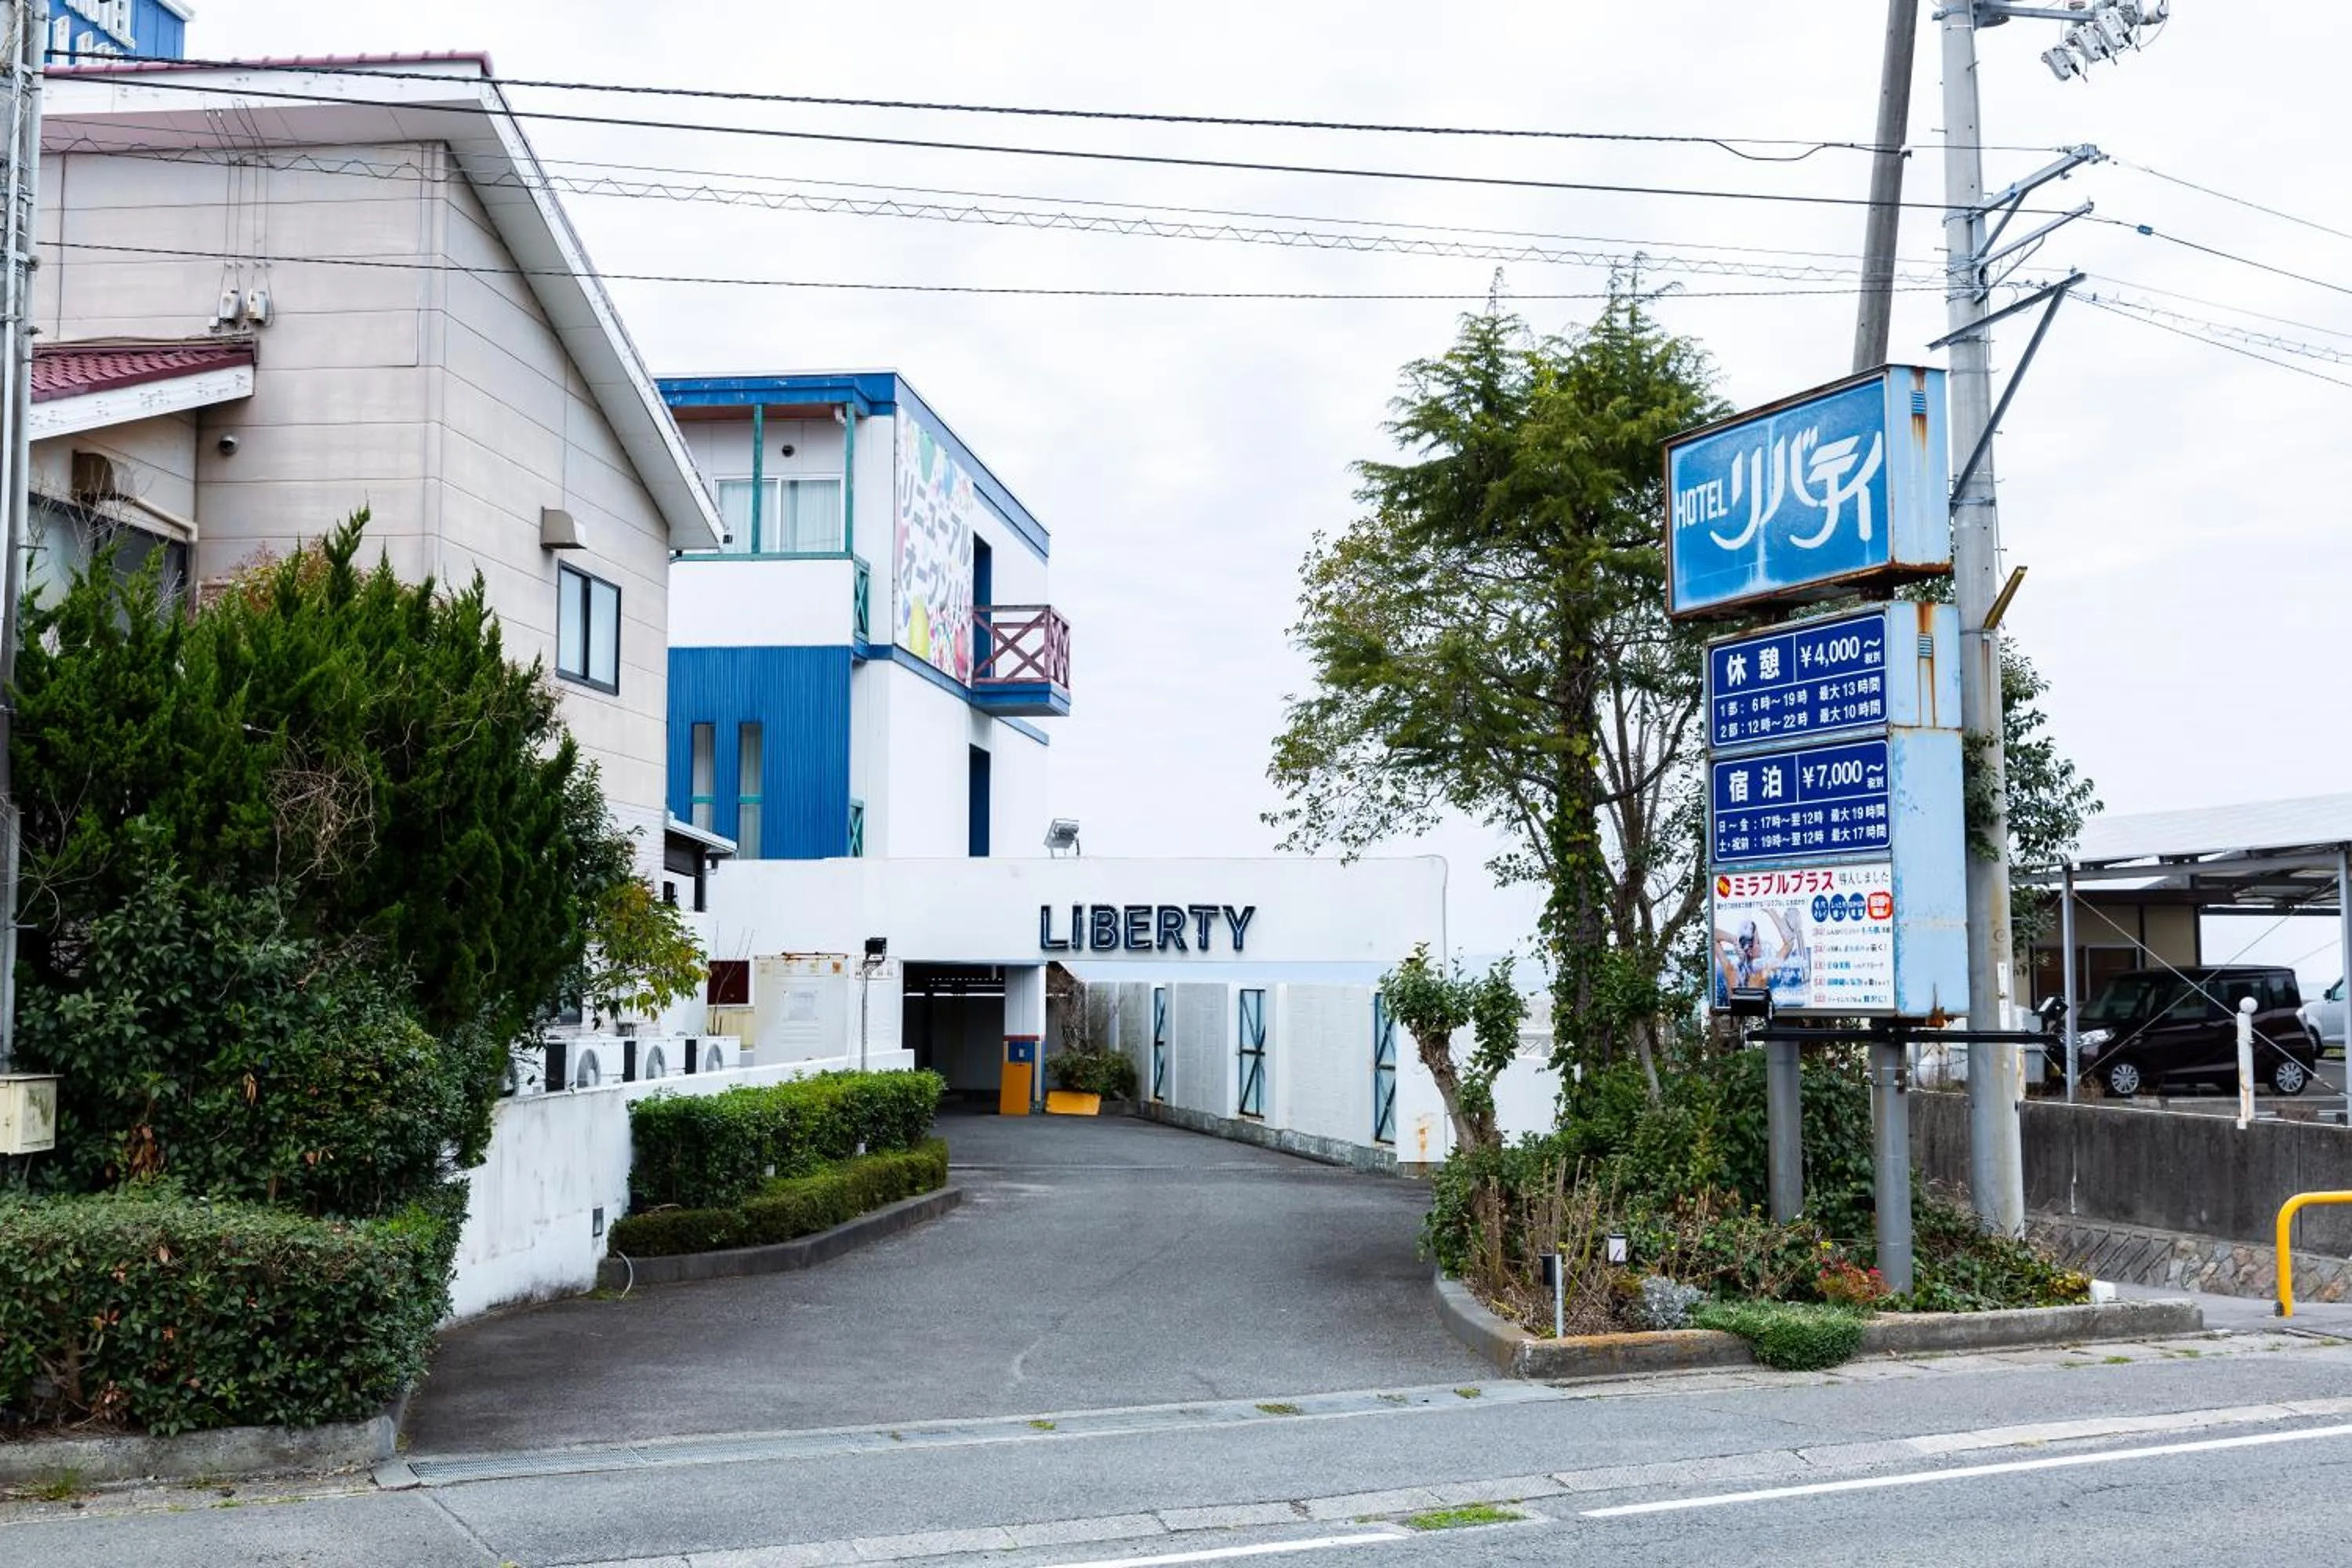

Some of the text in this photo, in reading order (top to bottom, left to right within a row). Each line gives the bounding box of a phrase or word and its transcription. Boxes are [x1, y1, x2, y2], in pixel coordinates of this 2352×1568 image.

[1675, 425, 1882, 550] HOTEL リバティ
[902, 468, 971, 567] リニューアル
[1726, 646, 1780, 687] 休憩
[1819, 677, 1880, 702] 最大13時間
[1820, 699, 1881, 724] 最大10時間
[1729, 765, 1782, 803] 宿泊
[1734, 871, 1834, 896] ミラブルプラス
[1040, 905, 1256, 952] LIBERTY
